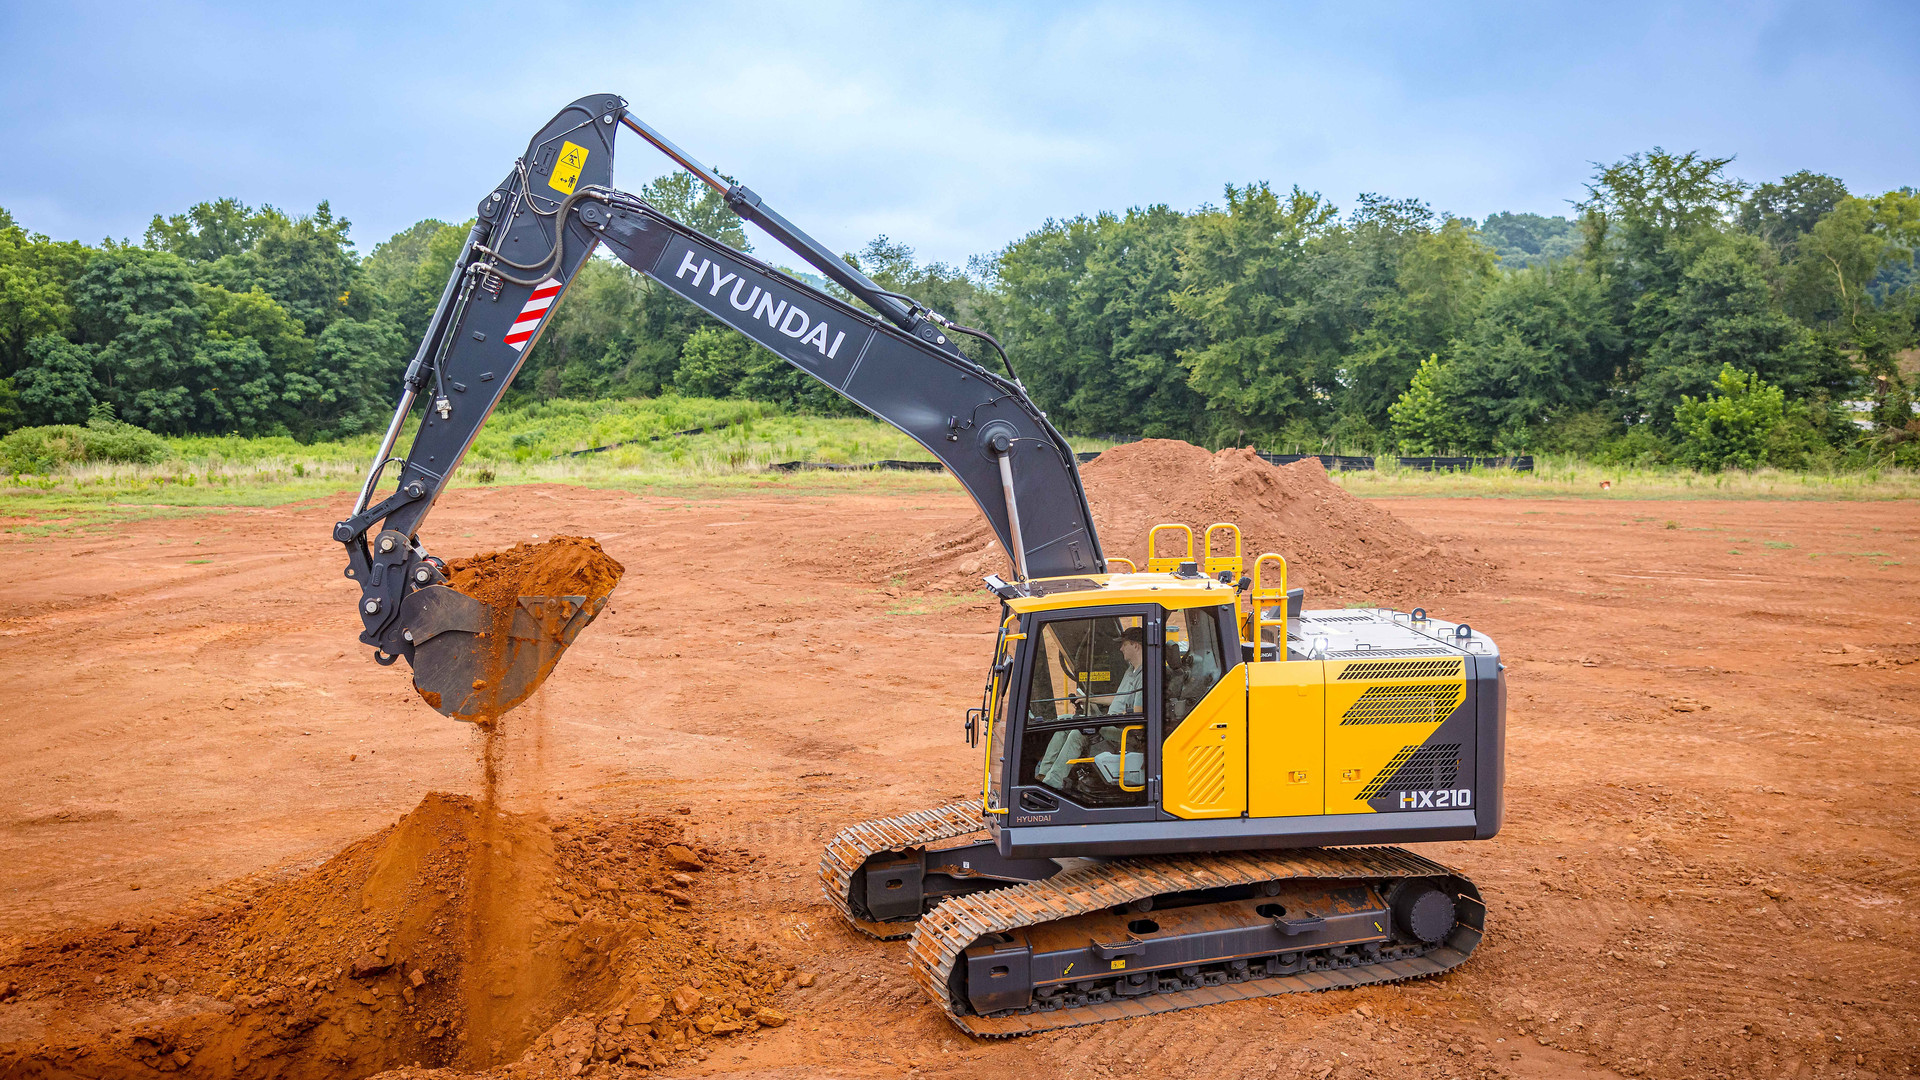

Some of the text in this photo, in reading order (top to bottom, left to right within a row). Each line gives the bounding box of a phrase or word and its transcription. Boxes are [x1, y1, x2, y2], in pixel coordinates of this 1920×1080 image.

[675, 249, 846, 360] HYUNDAI
[1399, 789, 1471, 809] HX210
[1016, 814, 1051, 823] HYUNDAI
